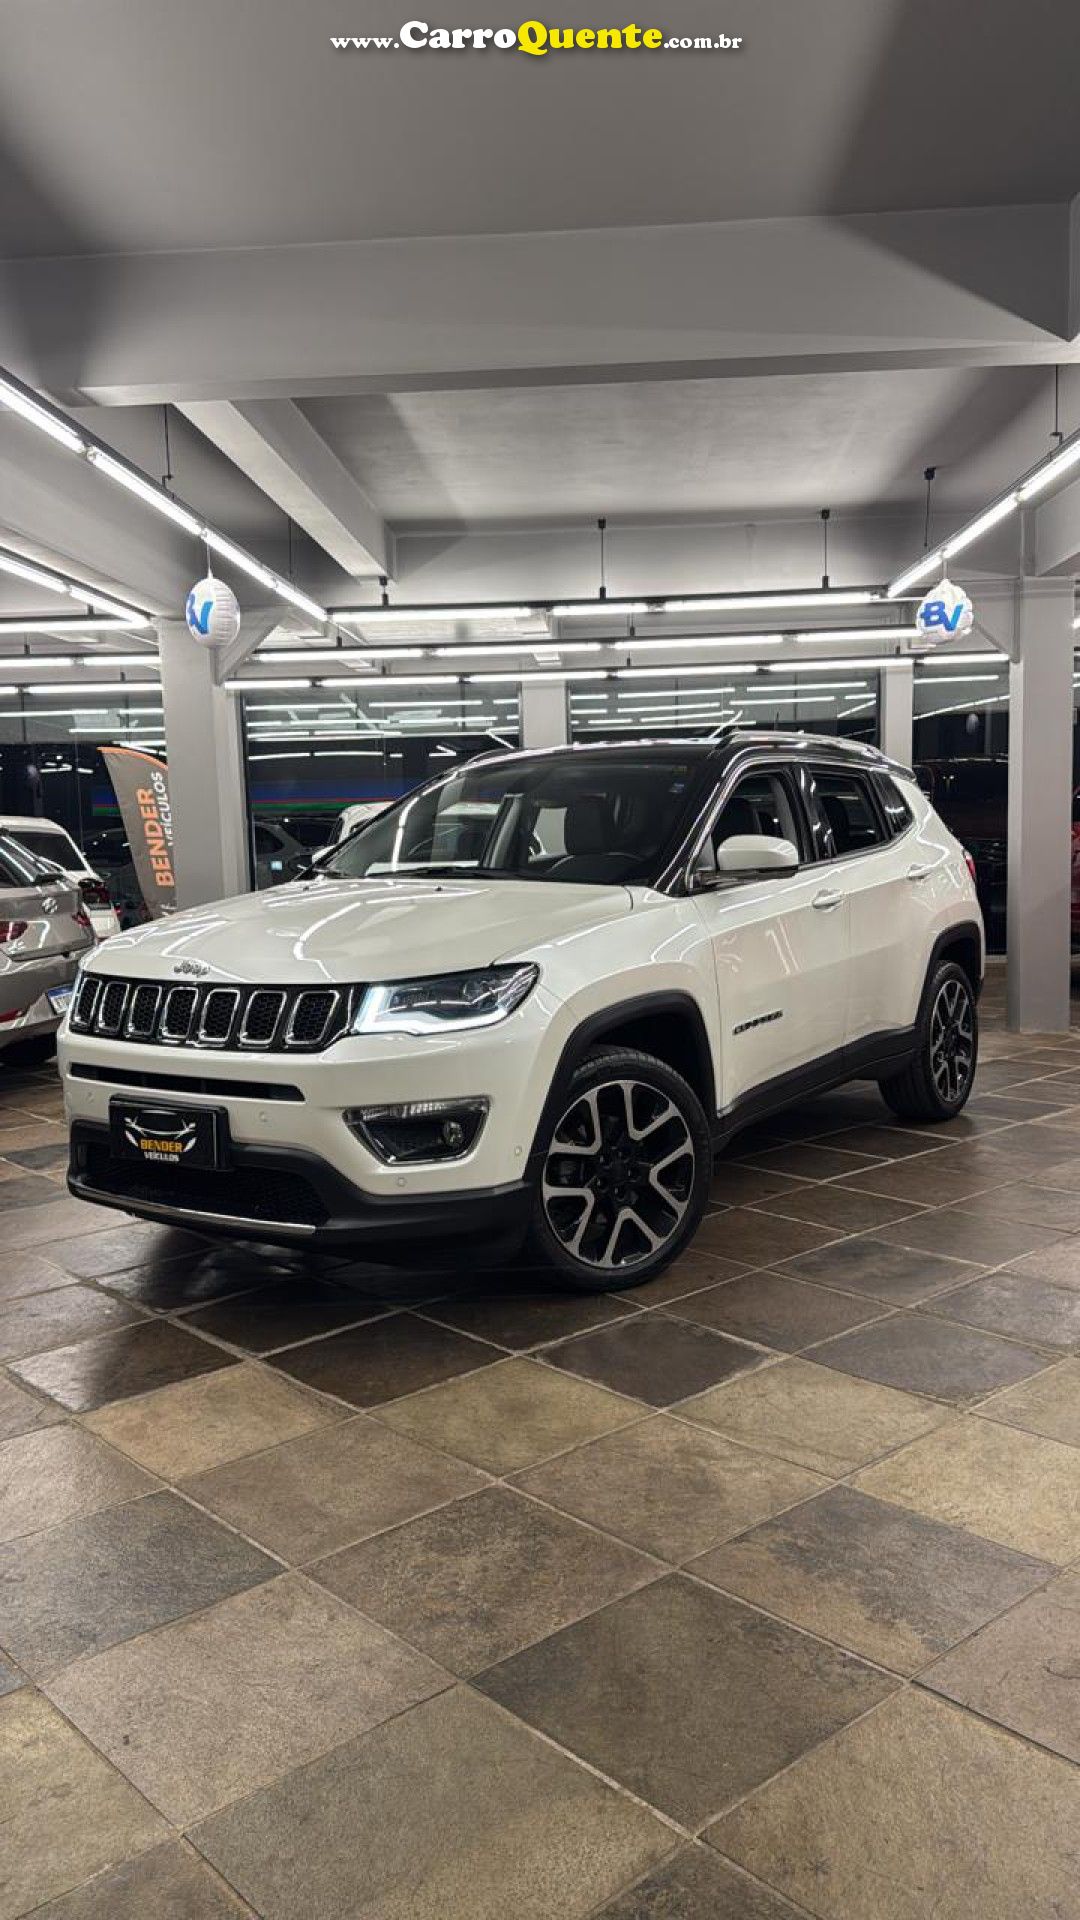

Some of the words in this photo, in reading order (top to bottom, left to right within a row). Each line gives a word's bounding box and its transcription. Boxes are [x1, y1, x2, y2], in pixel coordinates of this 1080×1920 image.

[921, 601, 963, 631] BV
[136, 788, 175, 887] BENDER
[140, 1139, 183, 1153] BENDER
